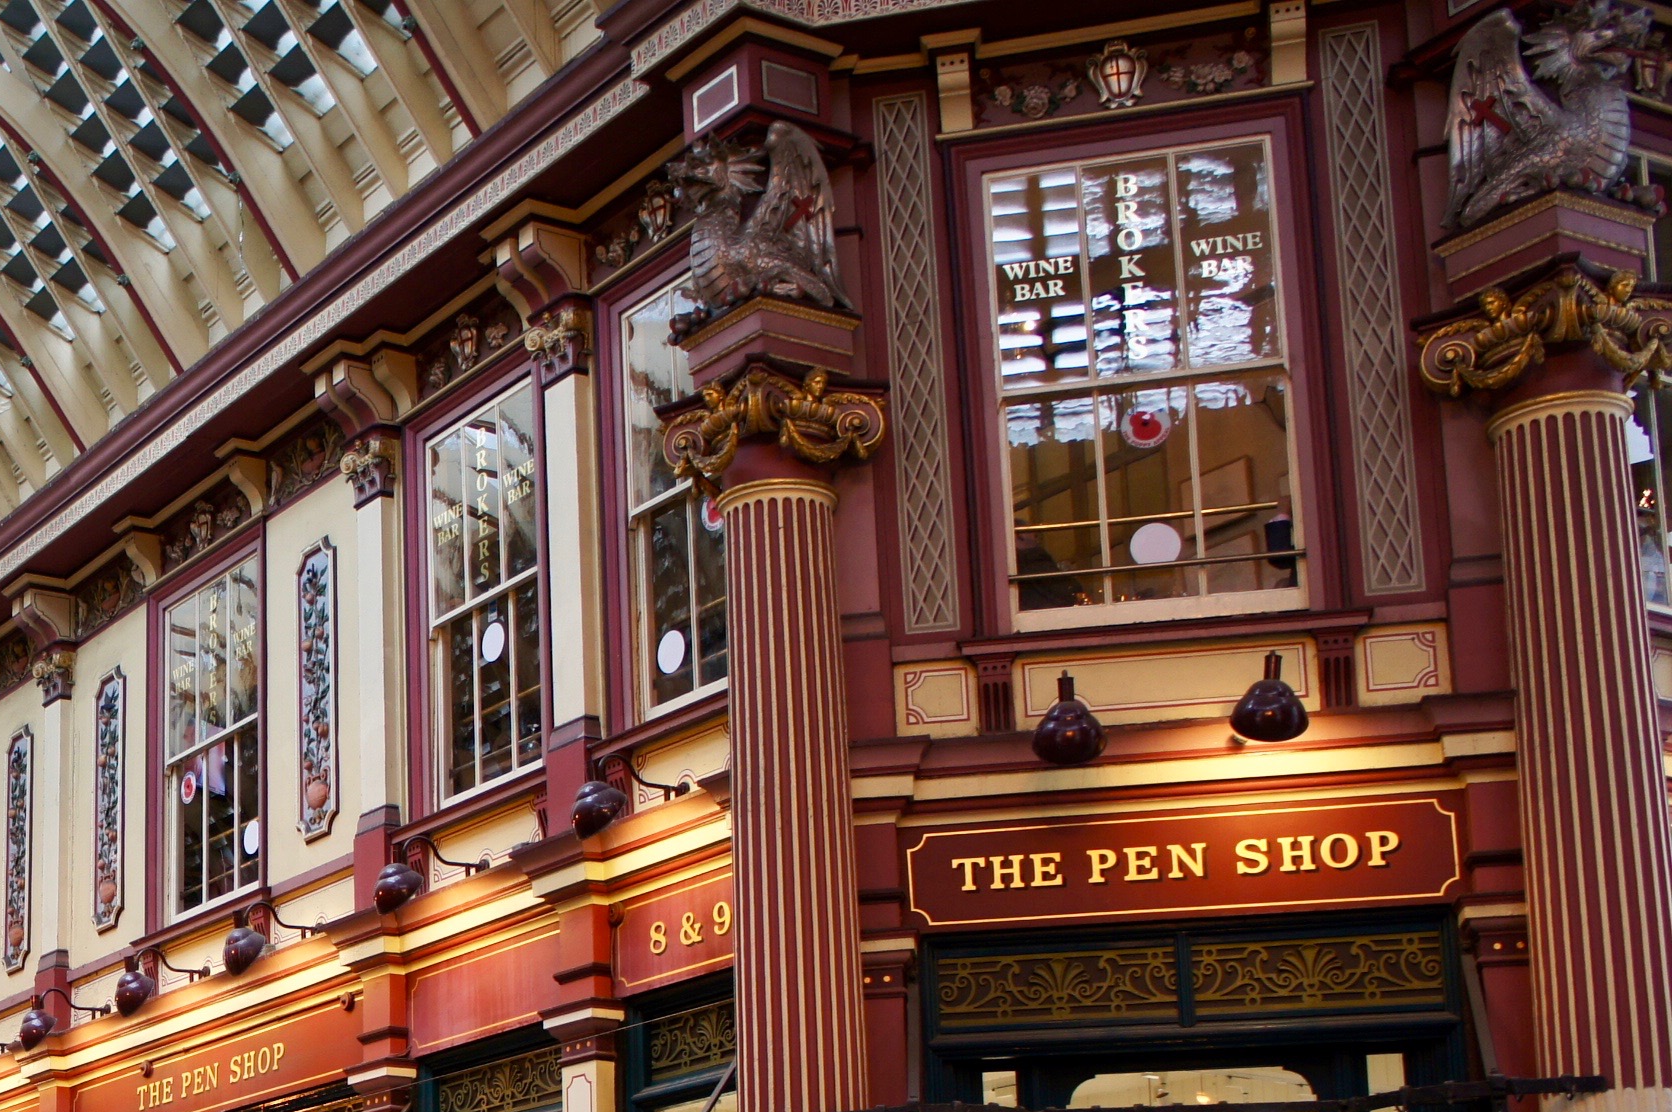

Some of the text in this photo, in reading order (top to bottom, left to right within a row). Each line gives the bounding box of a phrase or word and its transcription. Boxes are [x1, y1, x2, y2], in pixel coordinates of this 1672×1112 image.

[1190, 231, 1263, 257] WINE
[1003, 256, 1074, 281] WINE
[1115, 173, 1148, 361] BROKERS
[1201, 255, 1254, 278] BAR
[1013, 279, 1066, 302] BAR
[503, 458, 535, 488] WINE
[475, 427, 490, 583] BROKERS
[506, 478, 532, 507] BAR
[433, 503, 463, 531] WINE
[437, 522, 460, 547] BAR
[233, 621, 257, 645] WINE
[207, 593, 218, 726] BROKERS
[235, 639, 253, 662] BAR
[172, 660, 195, 683] WINE
[951, 829, 1401, 893] THE PEN SHOP
[649, 900, 732, 955] 8 & 9
[136, 1041, 285, 1112] THE PEN SHOP
